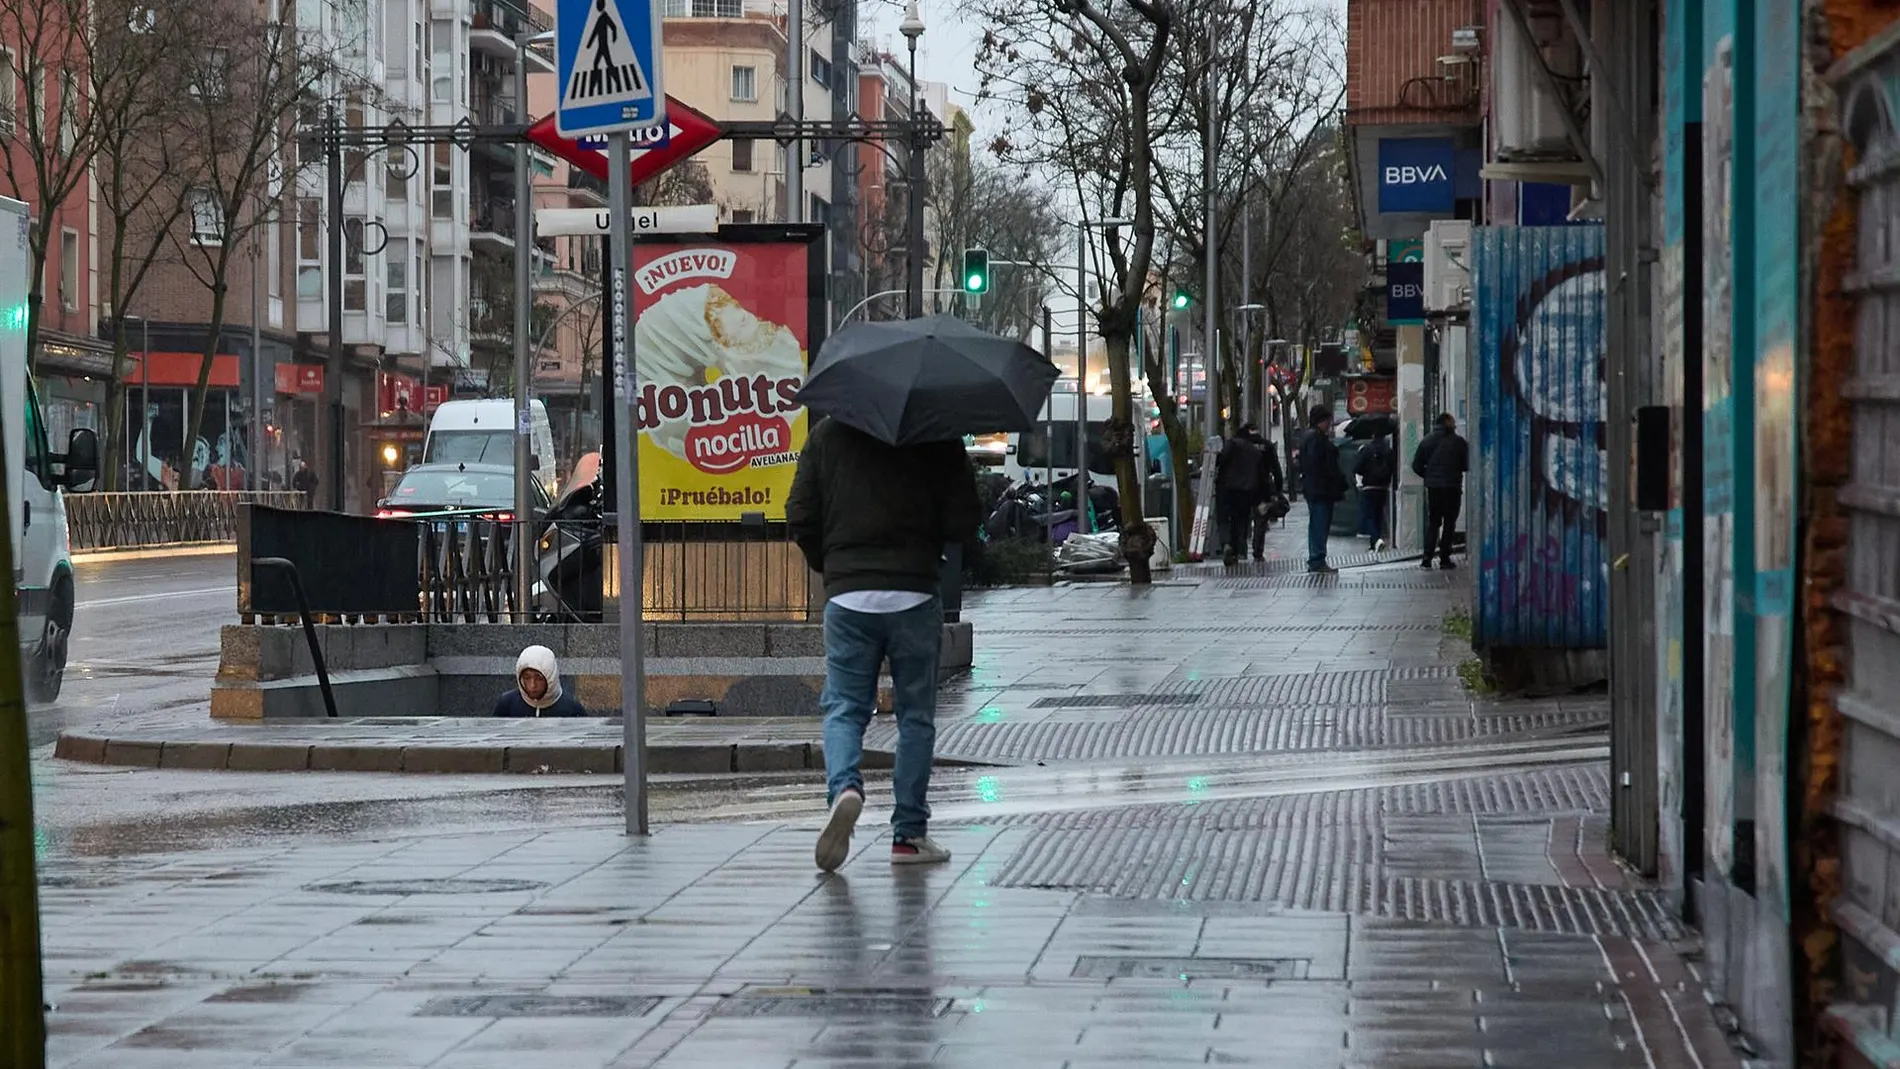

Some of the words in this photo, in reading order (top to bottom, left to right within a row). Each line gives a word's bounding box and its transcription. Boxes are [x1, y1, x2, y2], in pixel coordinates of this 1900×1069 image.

[1385, 164, 1447, 184] BBVA
[595, 211, 658, 231] Uel
[647, 254, 727, 289] ¡NUEVO!
[637, 374, 802, 428] donuts
[694, 423, 780, 457] nocilla
[660, 486, 771, 505] ¡Pruébalo!
